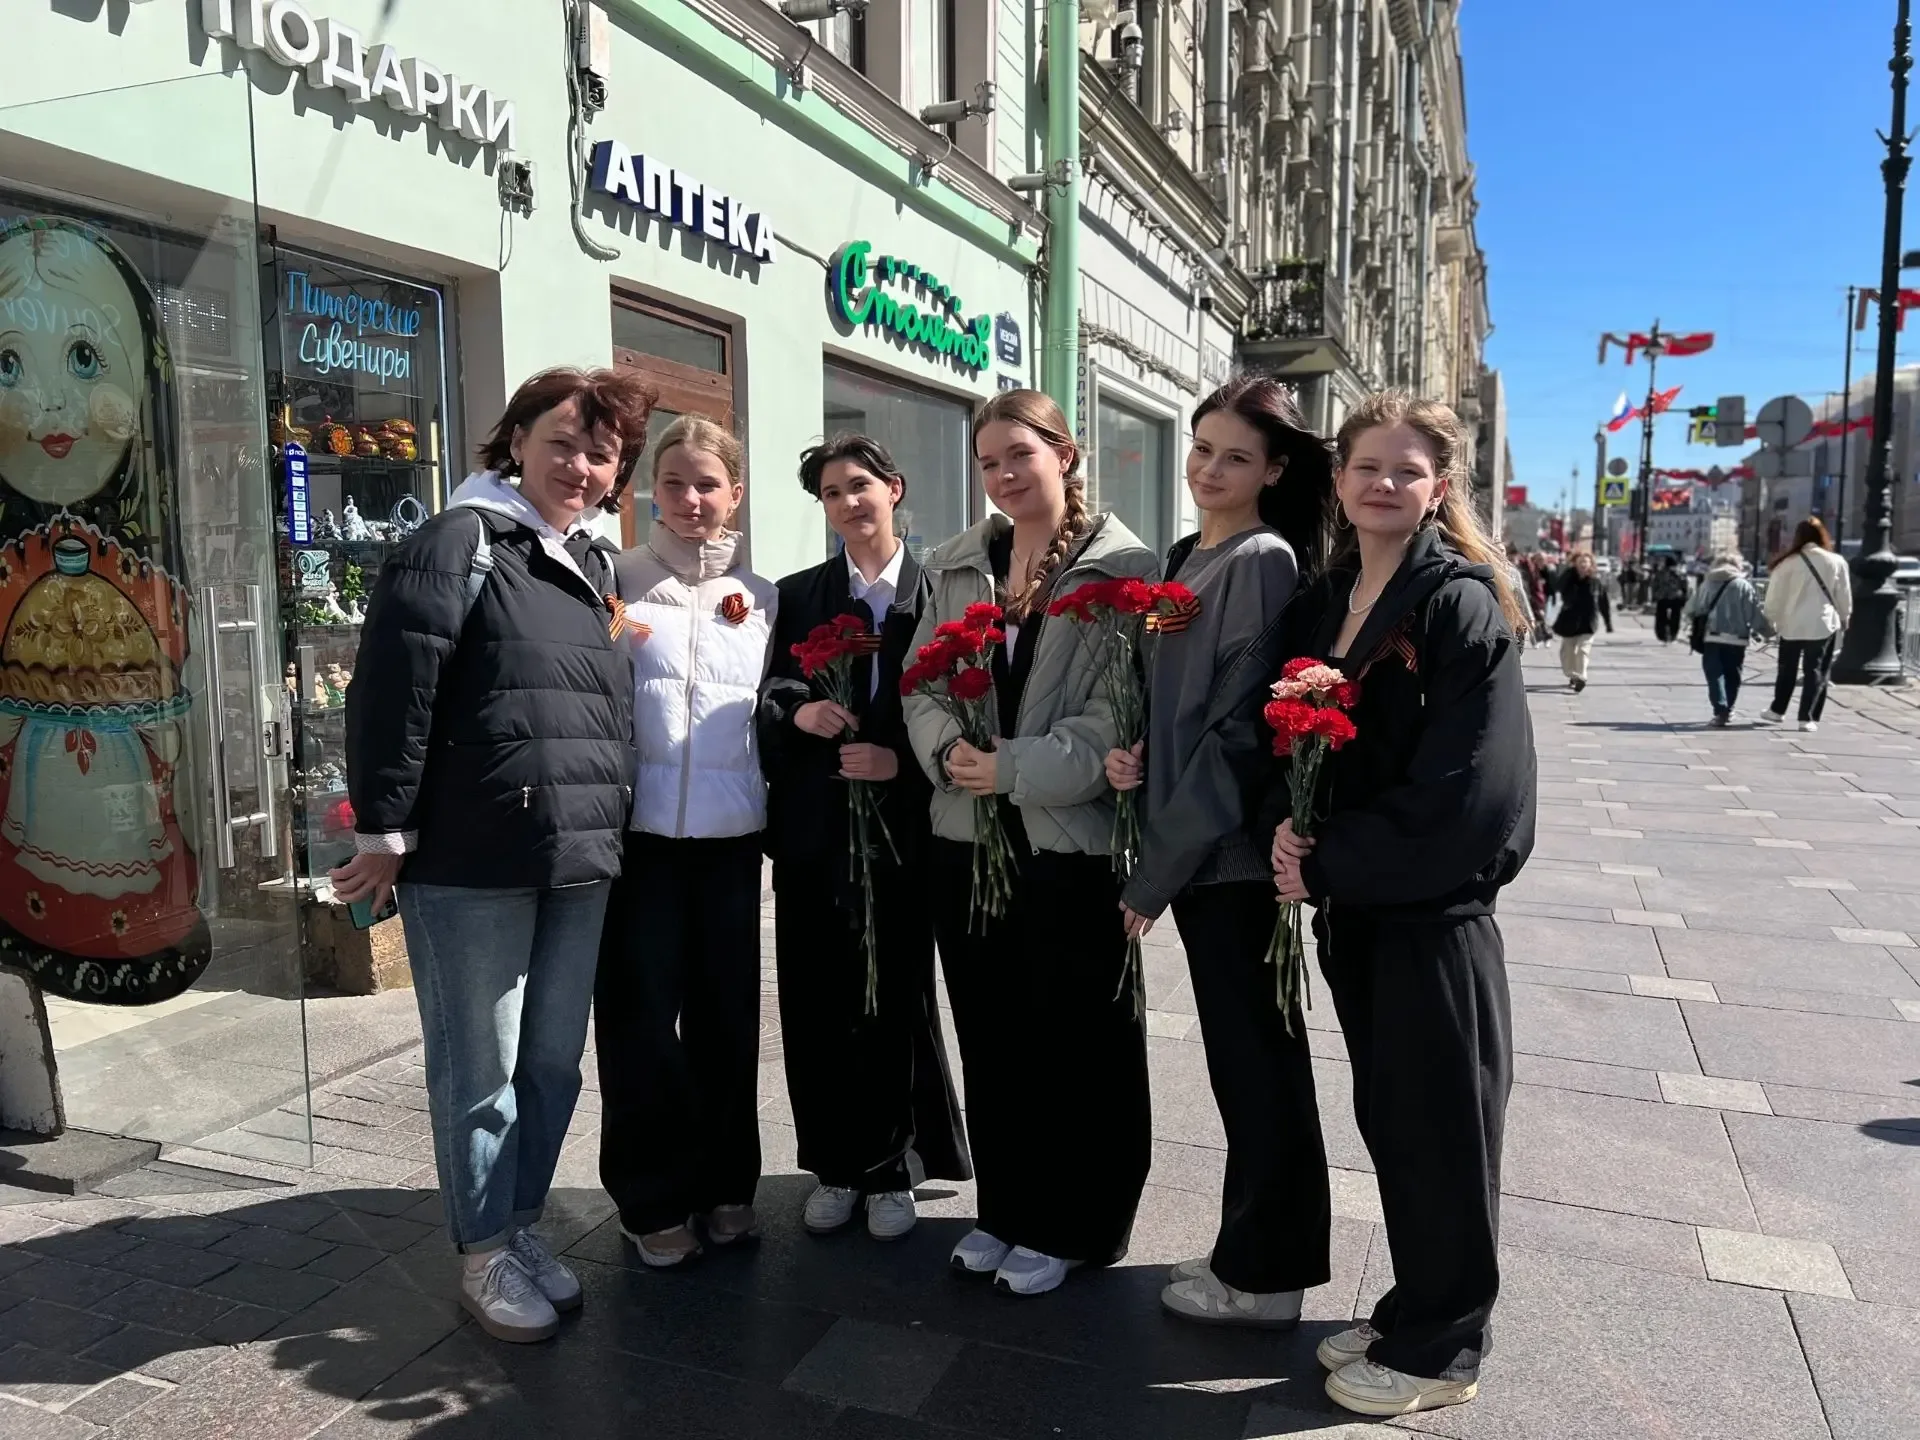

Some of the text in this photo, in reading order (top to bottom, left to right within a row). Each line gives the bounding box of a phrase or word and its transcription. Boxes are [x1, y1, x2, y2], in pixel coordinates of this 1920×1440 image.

[600, 139, 777, 263] АПТЕКА
[286, 271, 420, 336] Питерские
[838, 240, 991, 371] Столетов
[300, 321, 410, 385] Сувениры
